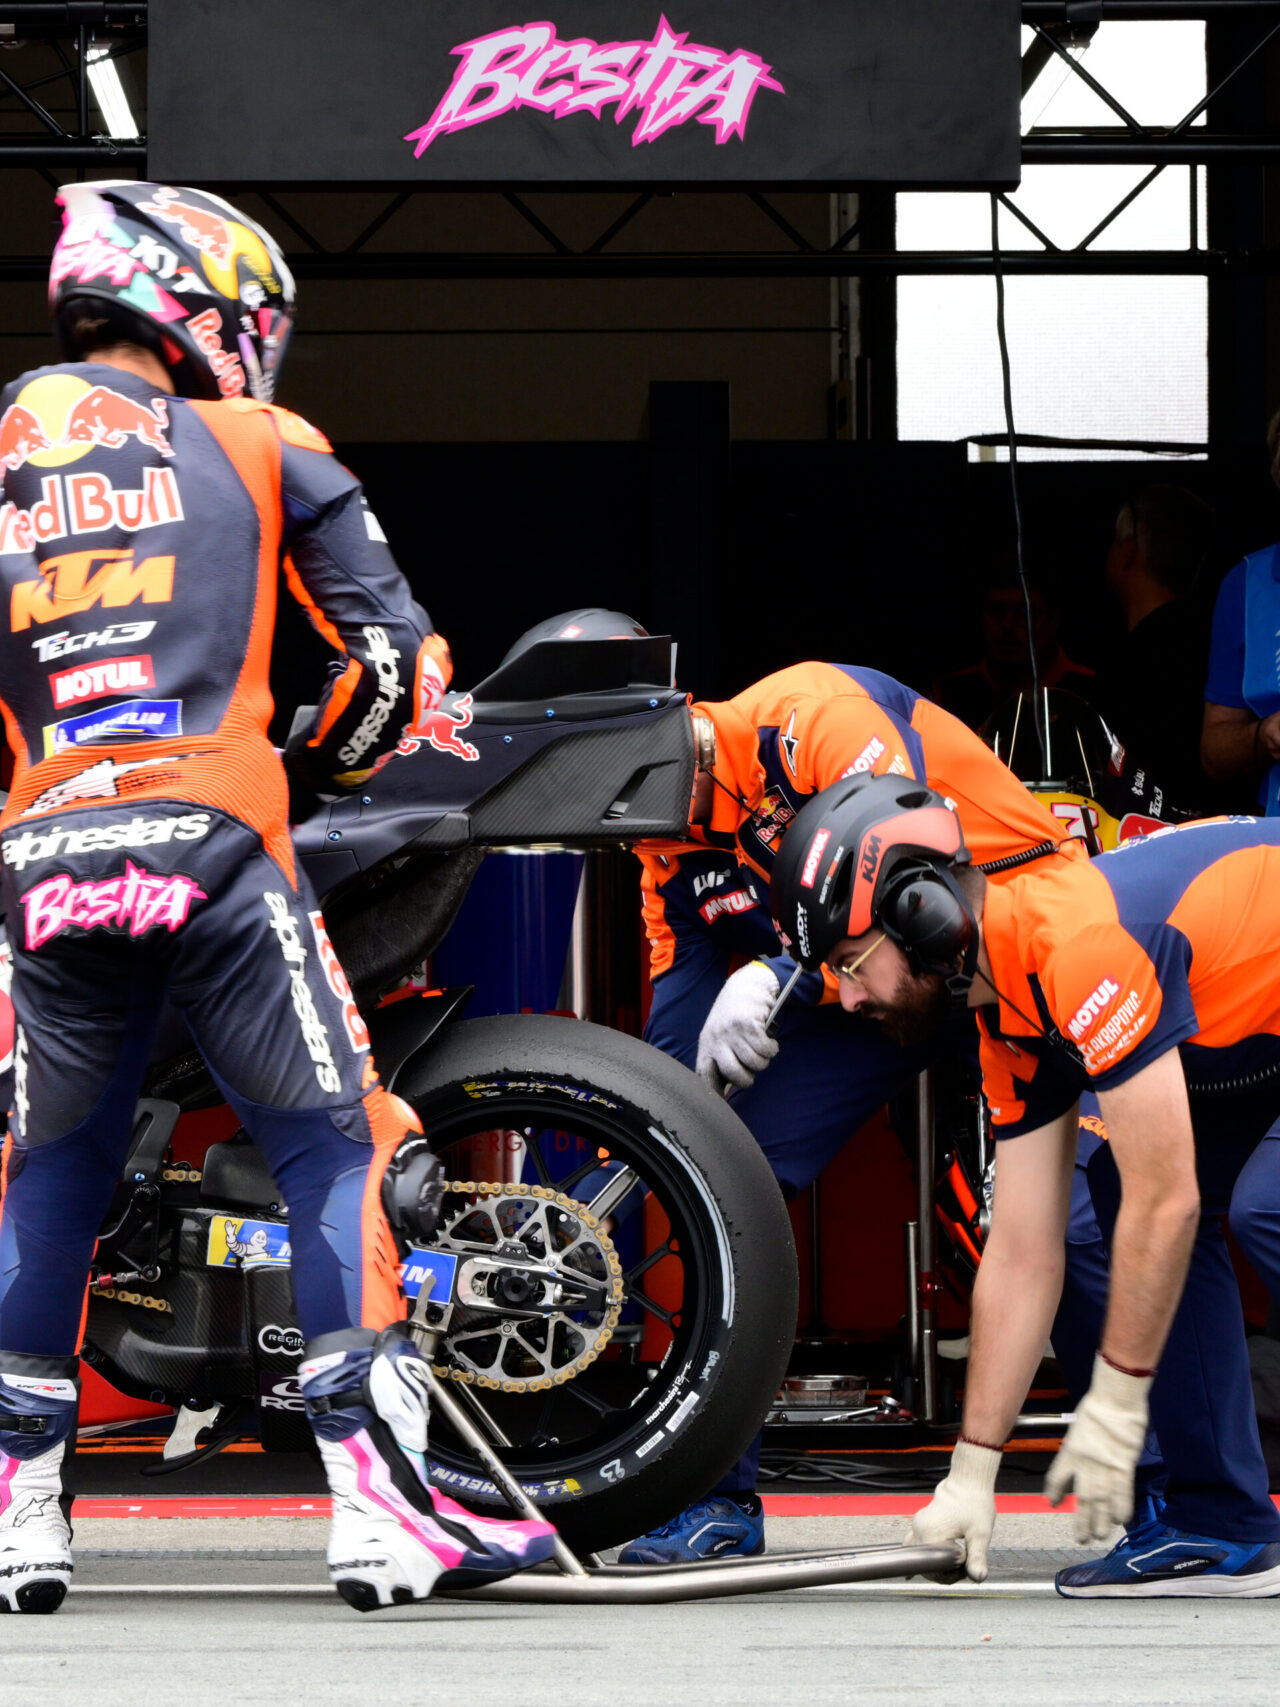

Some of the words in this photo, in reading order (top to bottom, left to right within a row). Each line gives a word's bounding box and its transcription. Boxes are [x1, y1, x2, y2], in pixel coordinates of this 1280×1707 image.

[65, 466, 185, 535] Bull
[10, 548, 177, 633] KTM
[1, 813, 212, 871] alpinestars
[803, 831, 830, 886] MOTUL
[861, 835, 882, 885] KTM
[1067, 978, 1119, 1040] MOTUL
[268, 1333, 306, 1345] REGIN
